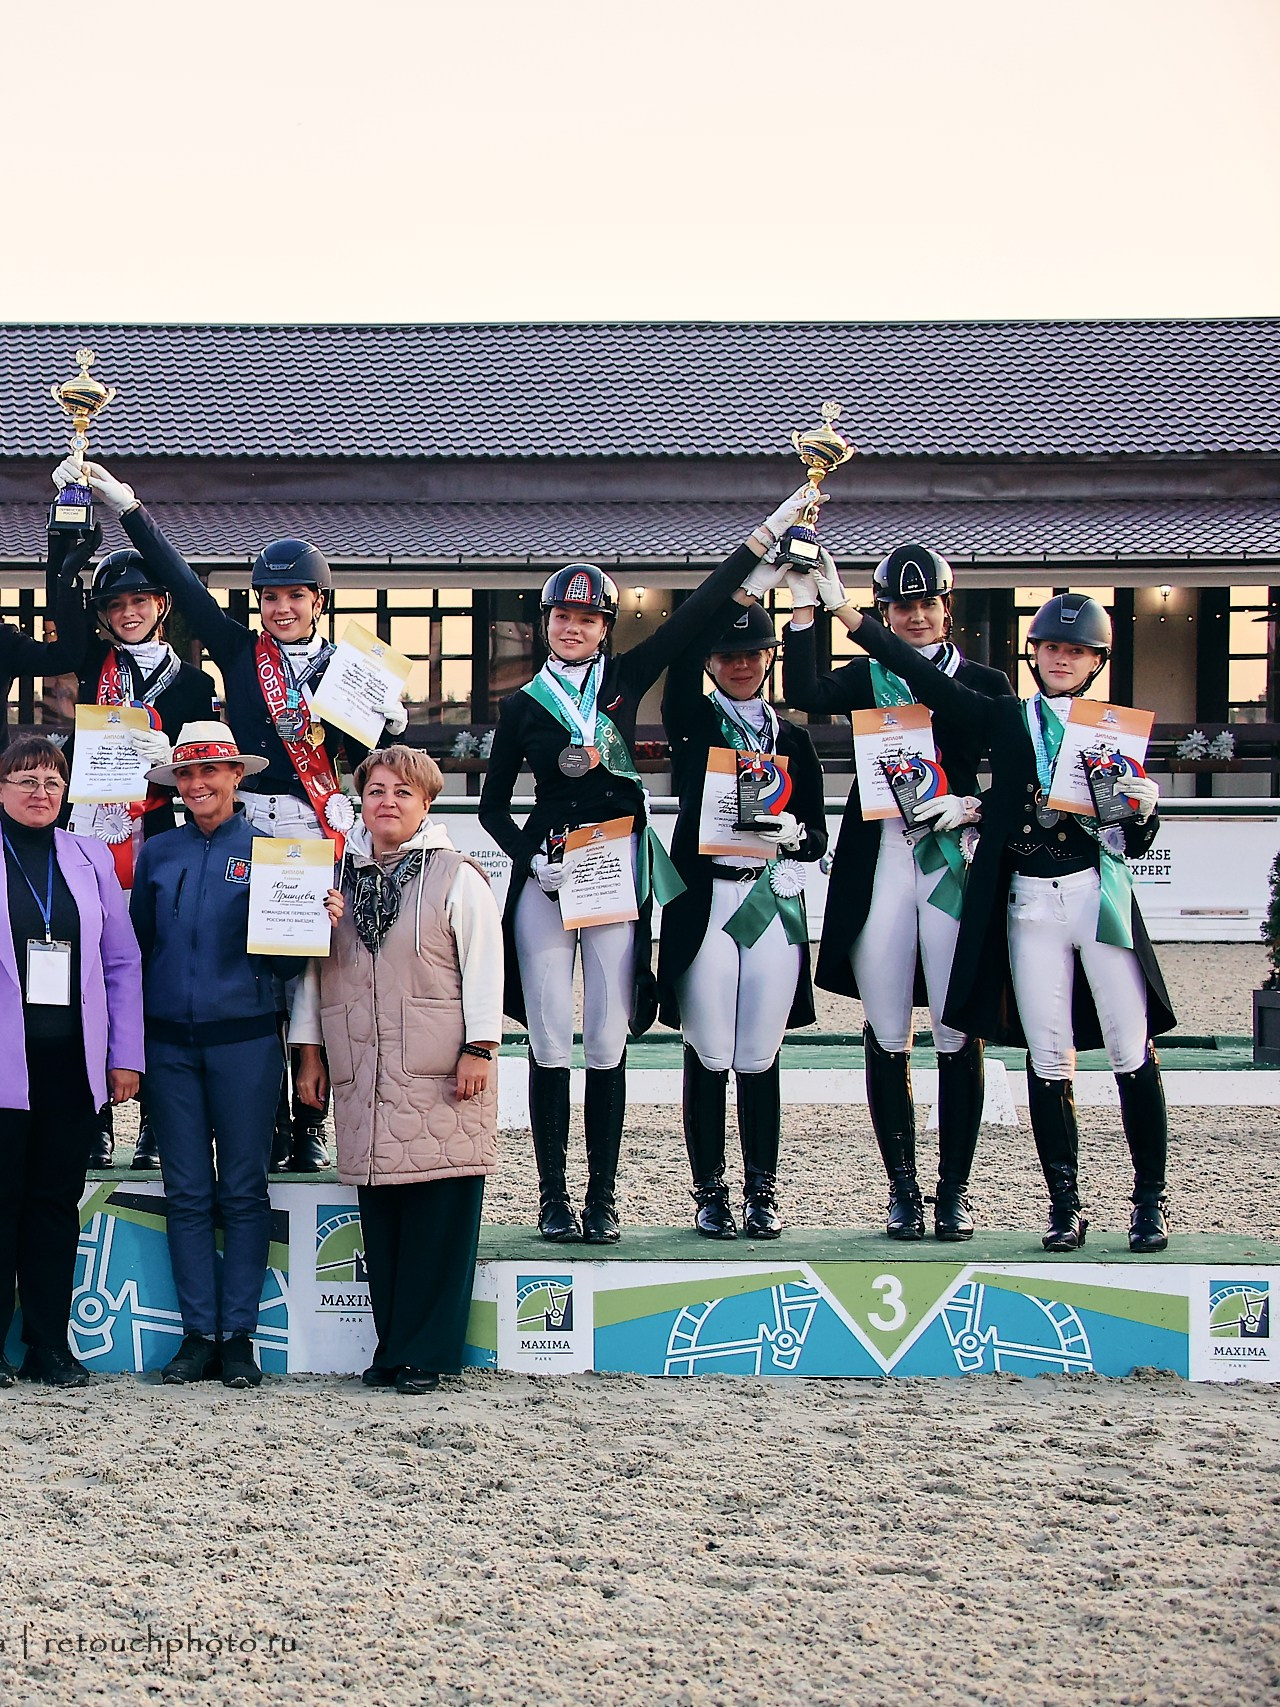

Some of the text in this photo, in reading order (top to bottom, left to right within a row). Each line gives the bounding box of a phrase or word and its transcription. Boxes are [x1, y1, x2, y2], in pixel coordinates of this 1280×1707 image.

[469, 850, 508, 859] ФЕДЕРАЦ
[273, 890, 316, 903] Принцева
[321, 1295, 372, 1306] MAXIM
[867, 1274, 907, 1332] 3
[521, 1340, 571, 1349] MAXIMA
[1214, 1346, 1267, 1356] MAXIMA
